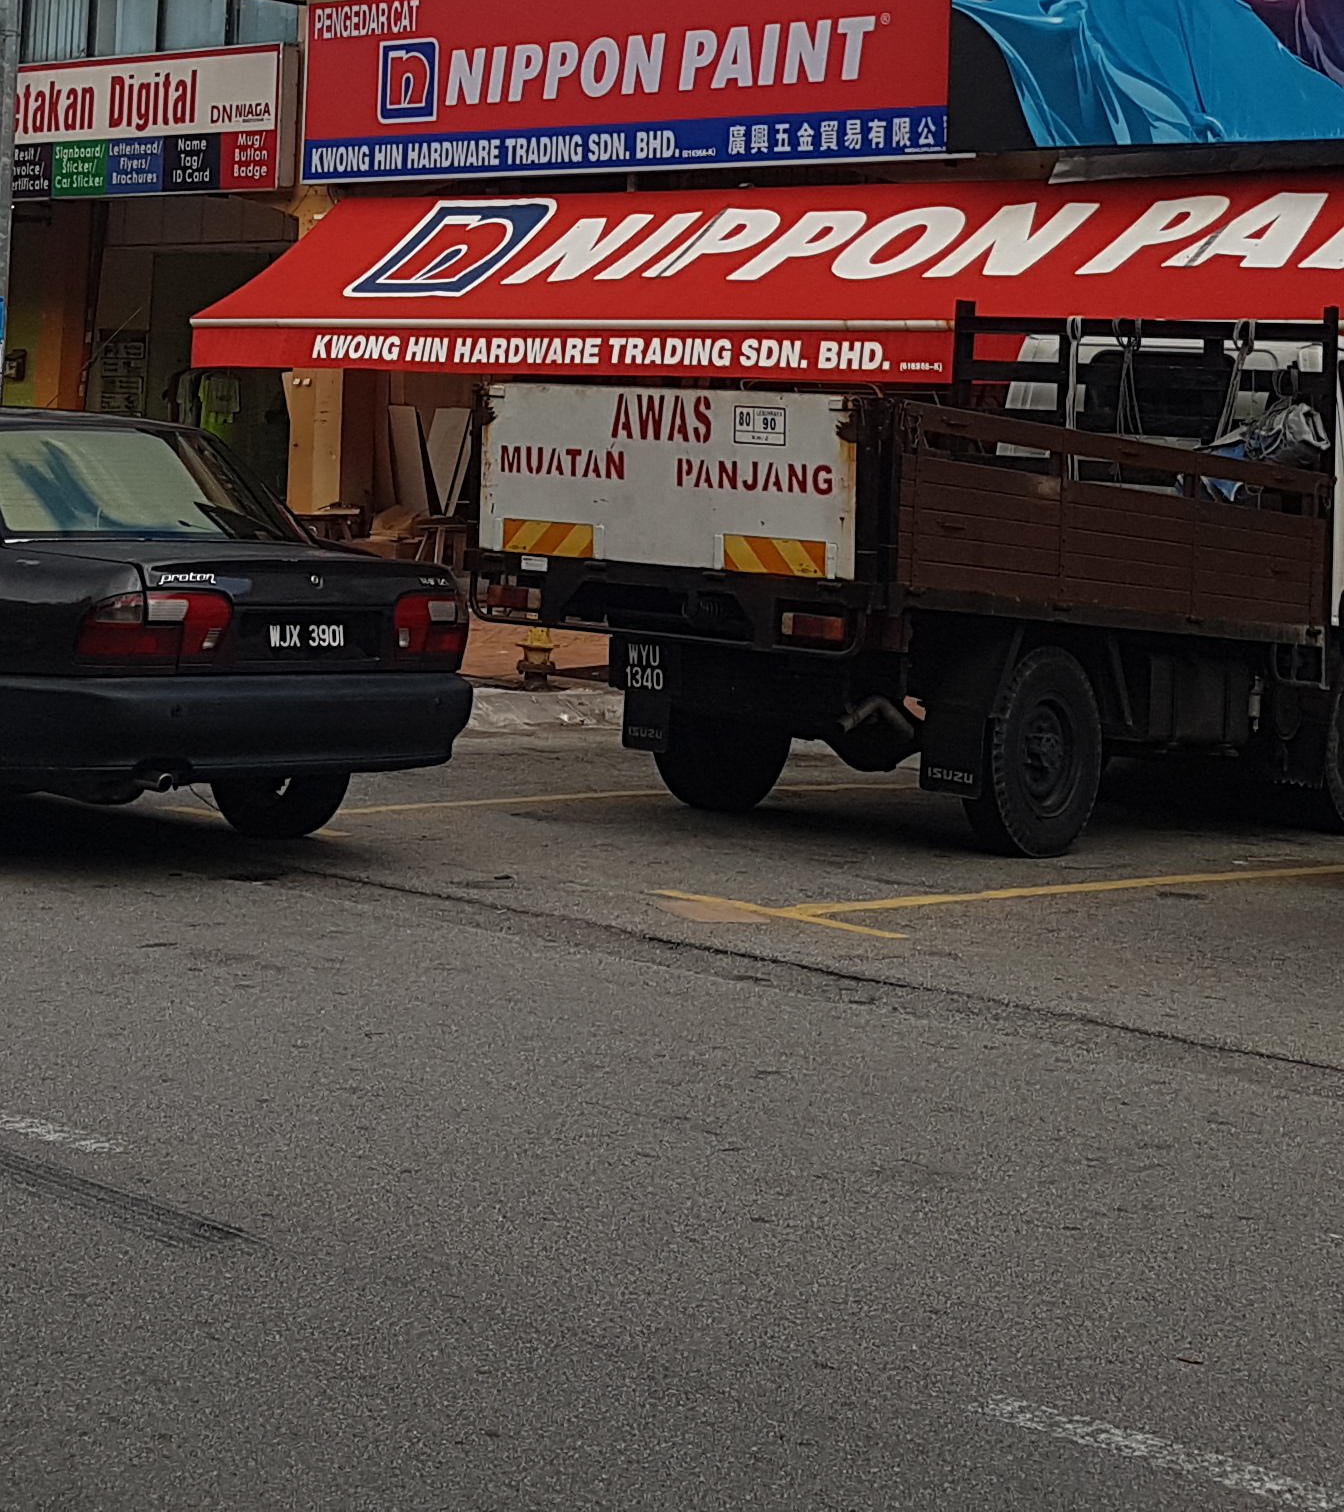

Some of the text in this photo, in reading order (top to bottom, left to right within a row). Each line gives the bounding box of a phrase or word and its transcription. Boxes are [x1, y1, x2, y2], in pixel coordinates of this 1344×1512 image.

[314, 0, 420, 40] PENGEDAR CAT
[445, 16, 875, 106] NIPPON PAINT
[109, 70, 197, 132] Digital
[211, 104, 233, 124] DN
[235, 102, 271, 118] NIAGA
[178, 138, 207, 151] Name
[238, 132, 265, 146] Mug/
[56, 143, 104, 161] Signboard/
[109, 140, 163, 156] Letterhead/
[234, 148, 268, 161] Button
[311, 130, 679, 174] KWONG HIN HARDWARE TRADING SDN. BHD.
[62, 160, 96, 174] Sticker/
[120, 156, 150, 170] Flyers/
[181, 153, 203, 169] Tag/
[112, 171, 157, 184] Brochures
[173, 168, 210, 183] ID Card
[234, 164, 268, 178] Badge
[56, 174, 103, 188] Car Sticker
[501, 203, 1100, 284] NIPPON
[311, 334, 889, 370] KWONG HIN HARDWARE TRADING SDN. BHD.
[611, 393, 712, 443] AWAS
[739, 411, 750, 426] 80
[762, 417, 776, 430] 90
[500, 445, 834, 495] MUATAN PANJANG
[159, 572, 216, 586] proton
[270, 625, 344, 647] WJX 3901
[628, 643, 660, 666] WYU
[625, 667, 664, 690] 1340
[628, 726, 662, 739] ISUZU
[926, 766, 974, 784] ISUZU
